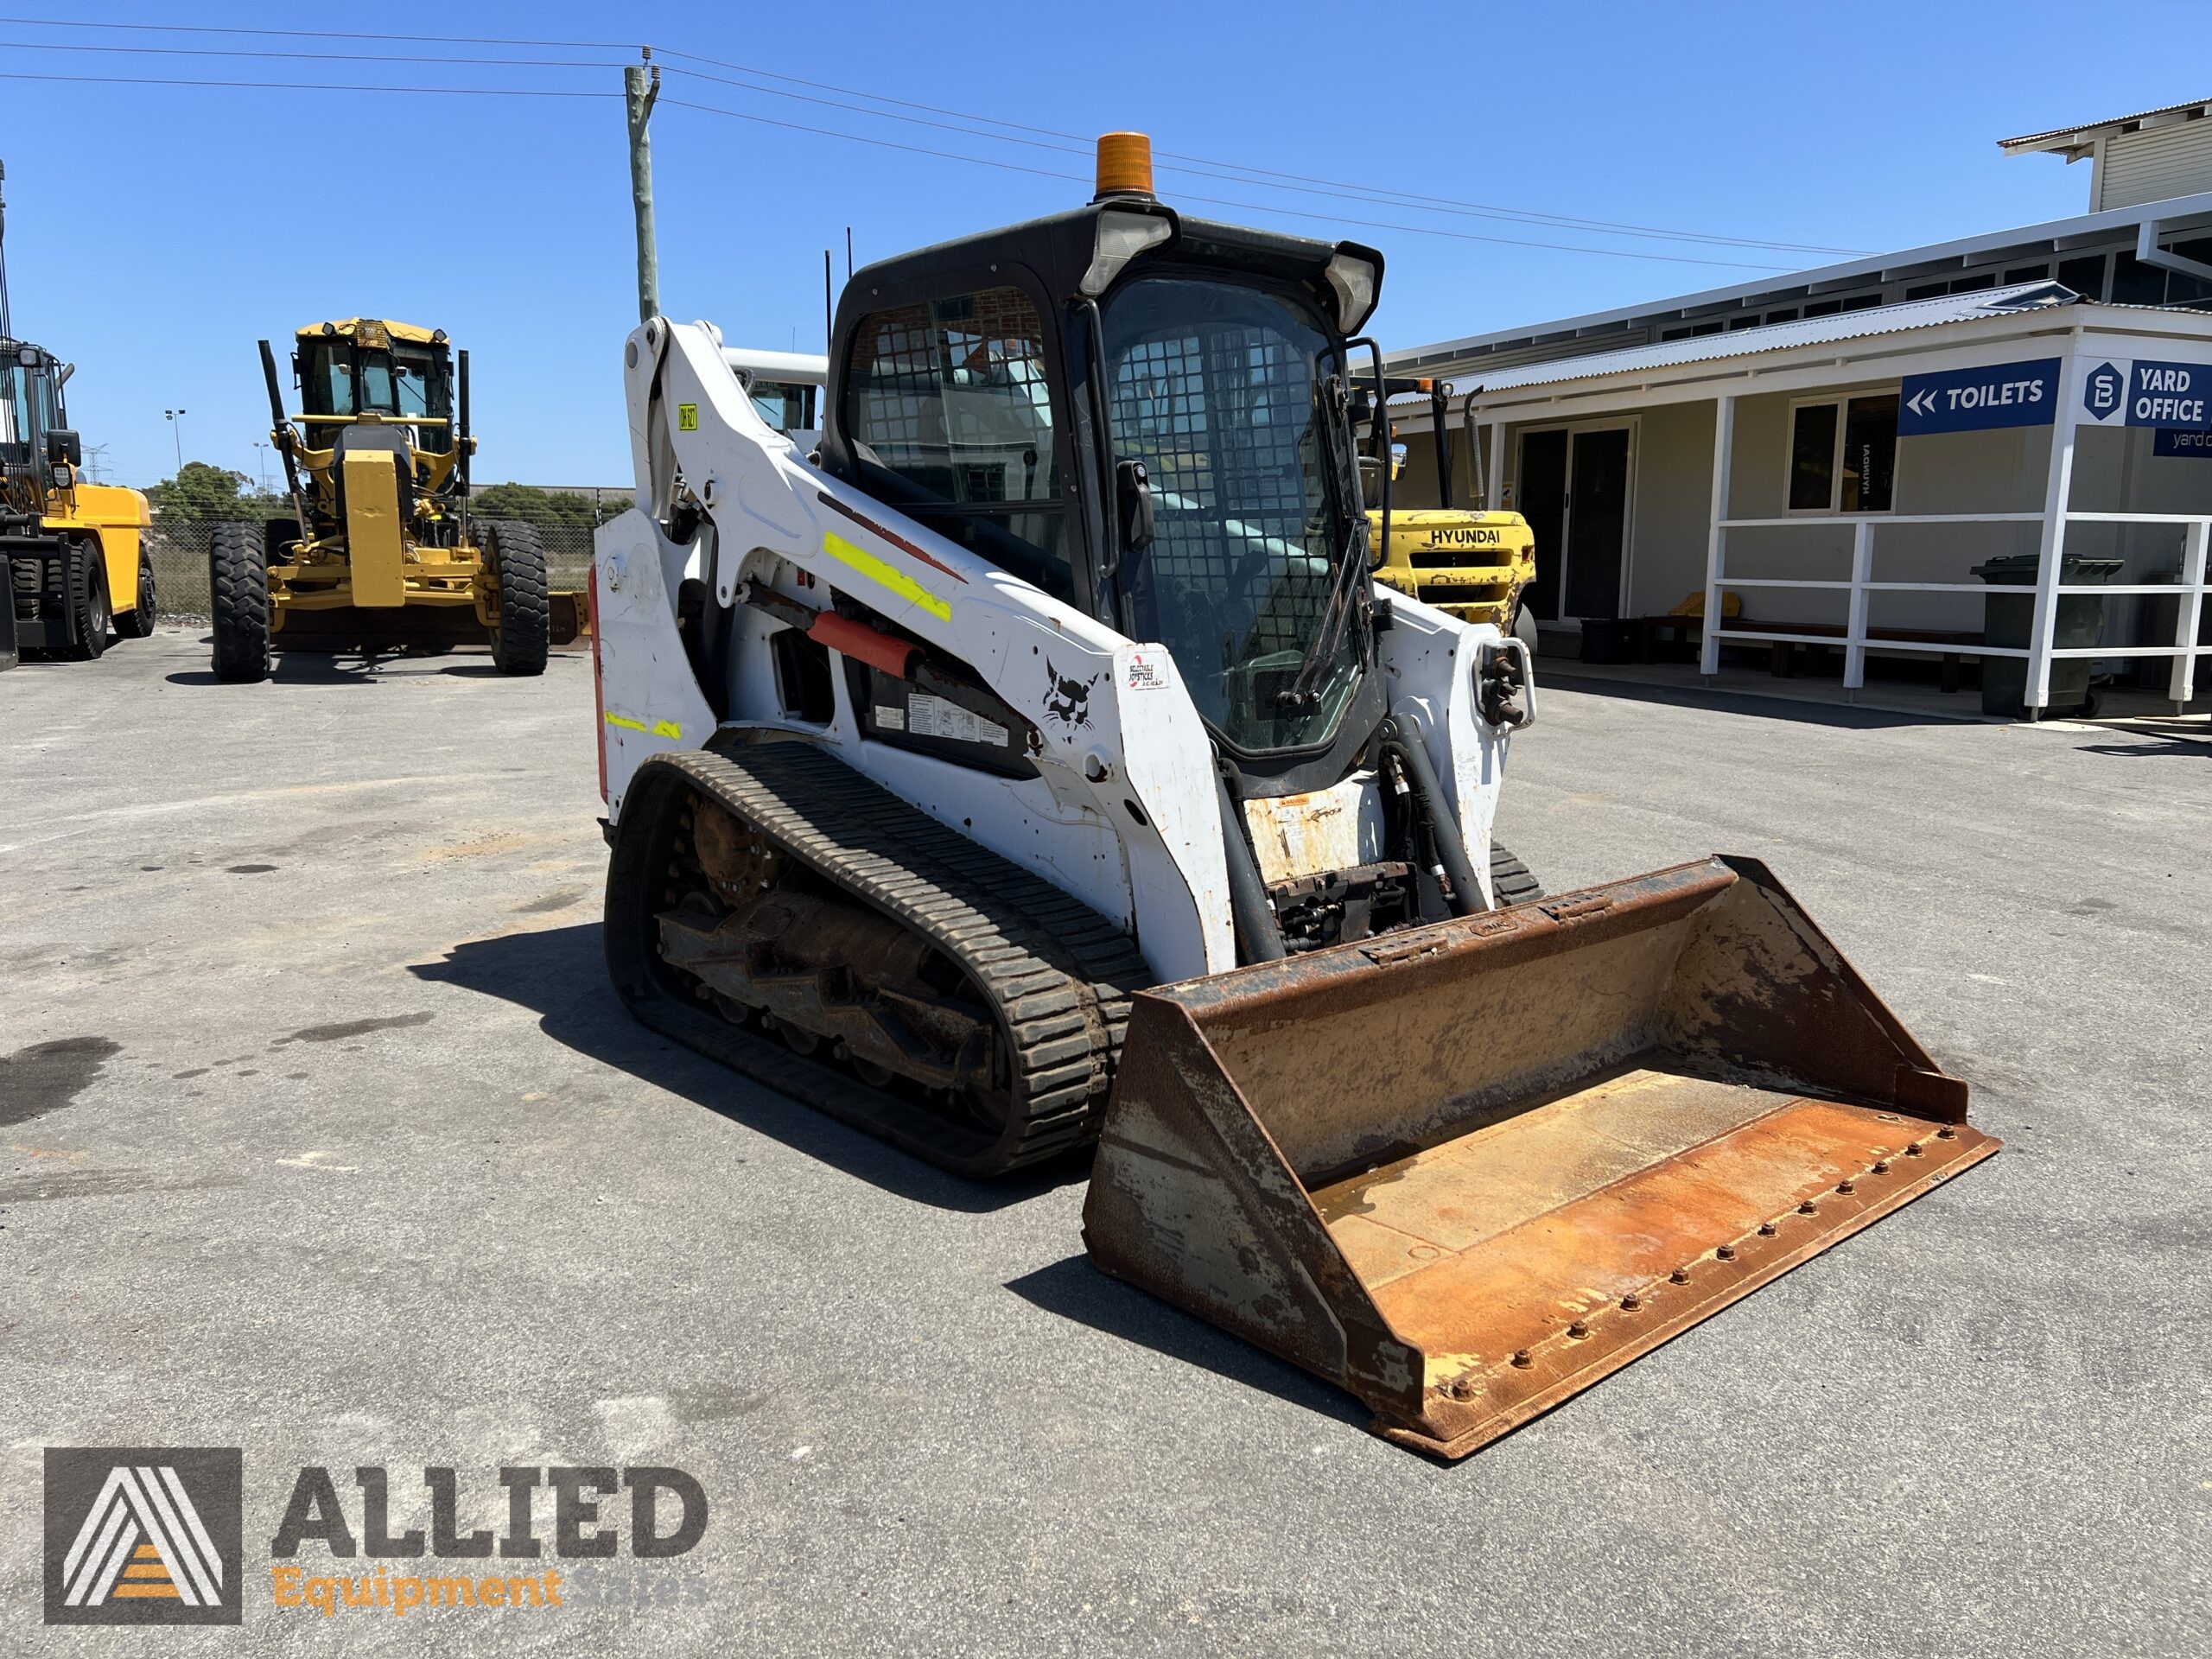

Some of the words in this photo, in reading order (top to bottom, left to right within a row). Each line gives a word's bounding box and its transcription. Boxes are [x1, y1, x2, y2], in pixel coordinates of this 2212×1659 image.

[2140, 368, 2190, 391] YARD
[1947, 379, 2044, 410] TOILETS
[2135, 397, 2204, 422] OFFICE
[2173, 431, 2204, 448] yard
[1431, 530, 1500, 543] HYUNDAI
